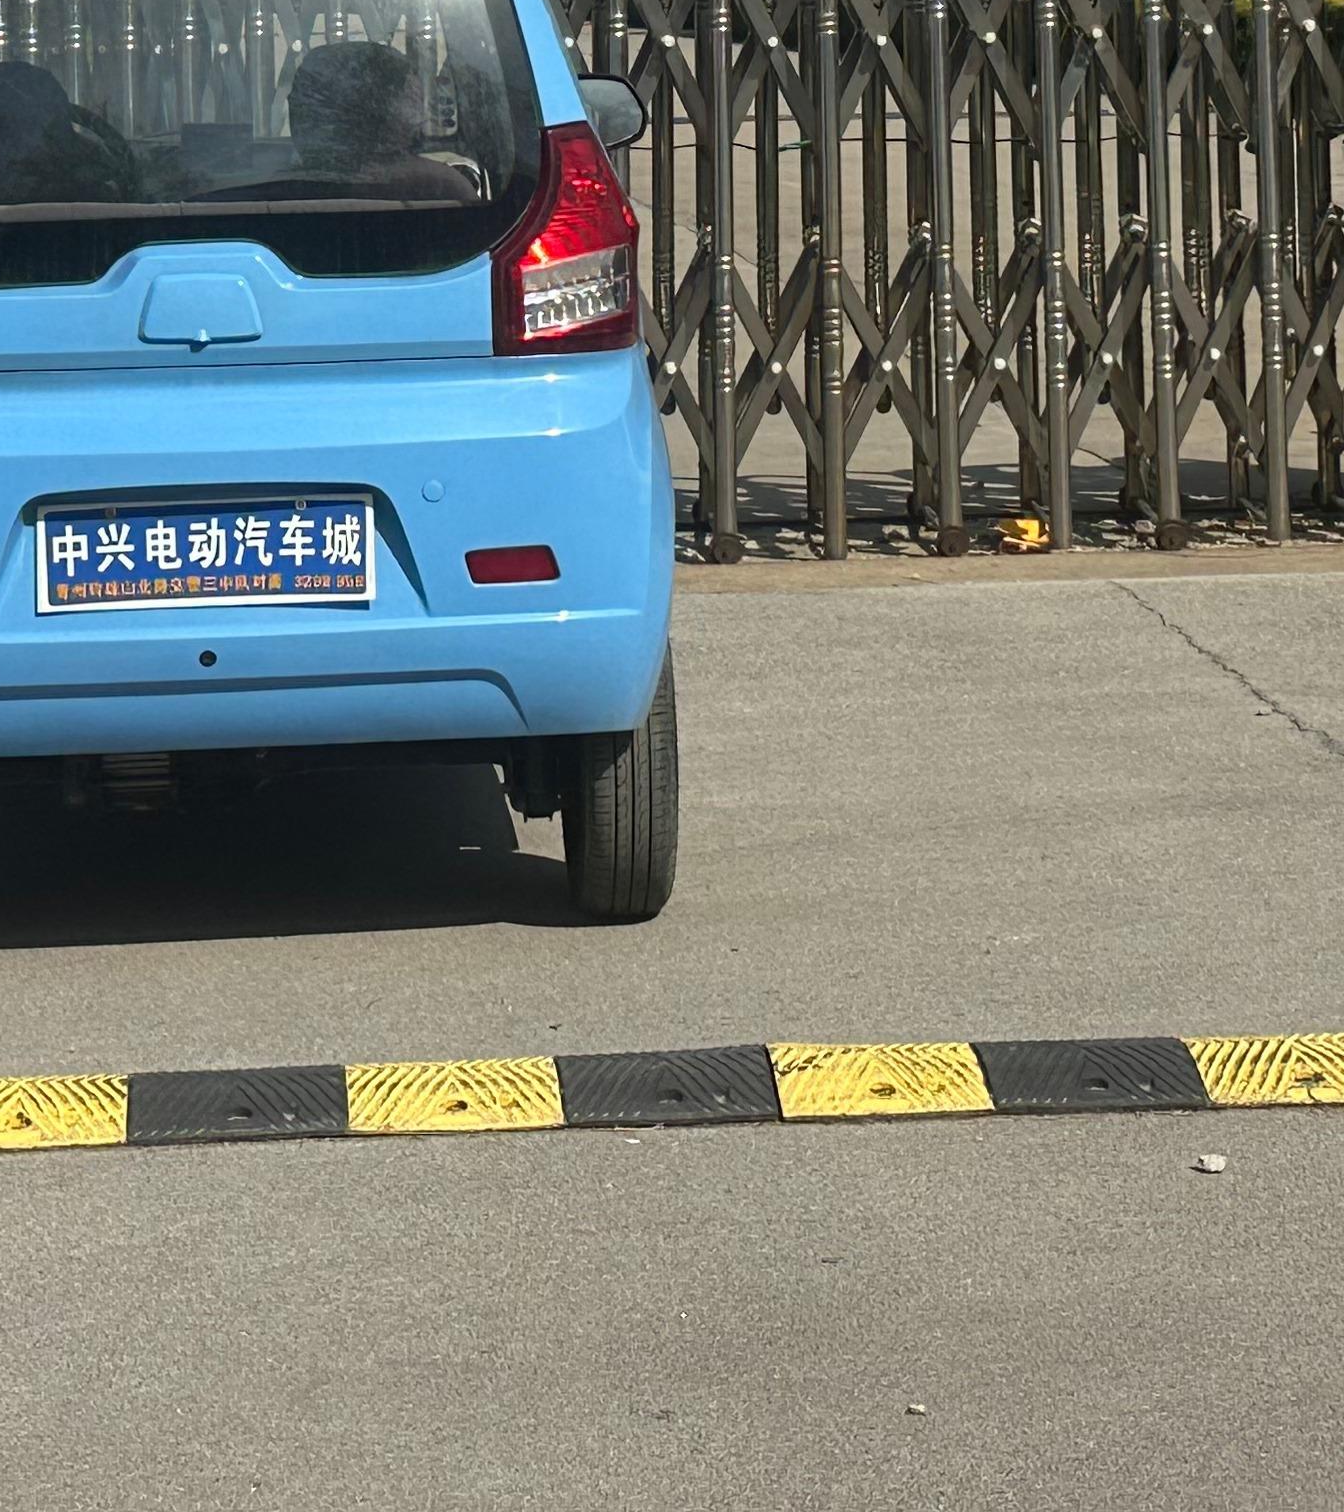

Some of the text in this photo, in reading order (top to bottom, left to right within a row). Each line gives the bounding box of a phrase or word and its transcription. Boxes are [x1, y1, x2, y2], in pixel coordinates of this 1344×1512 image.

[52, 514, 362, 578] 中兴电动汽车城
